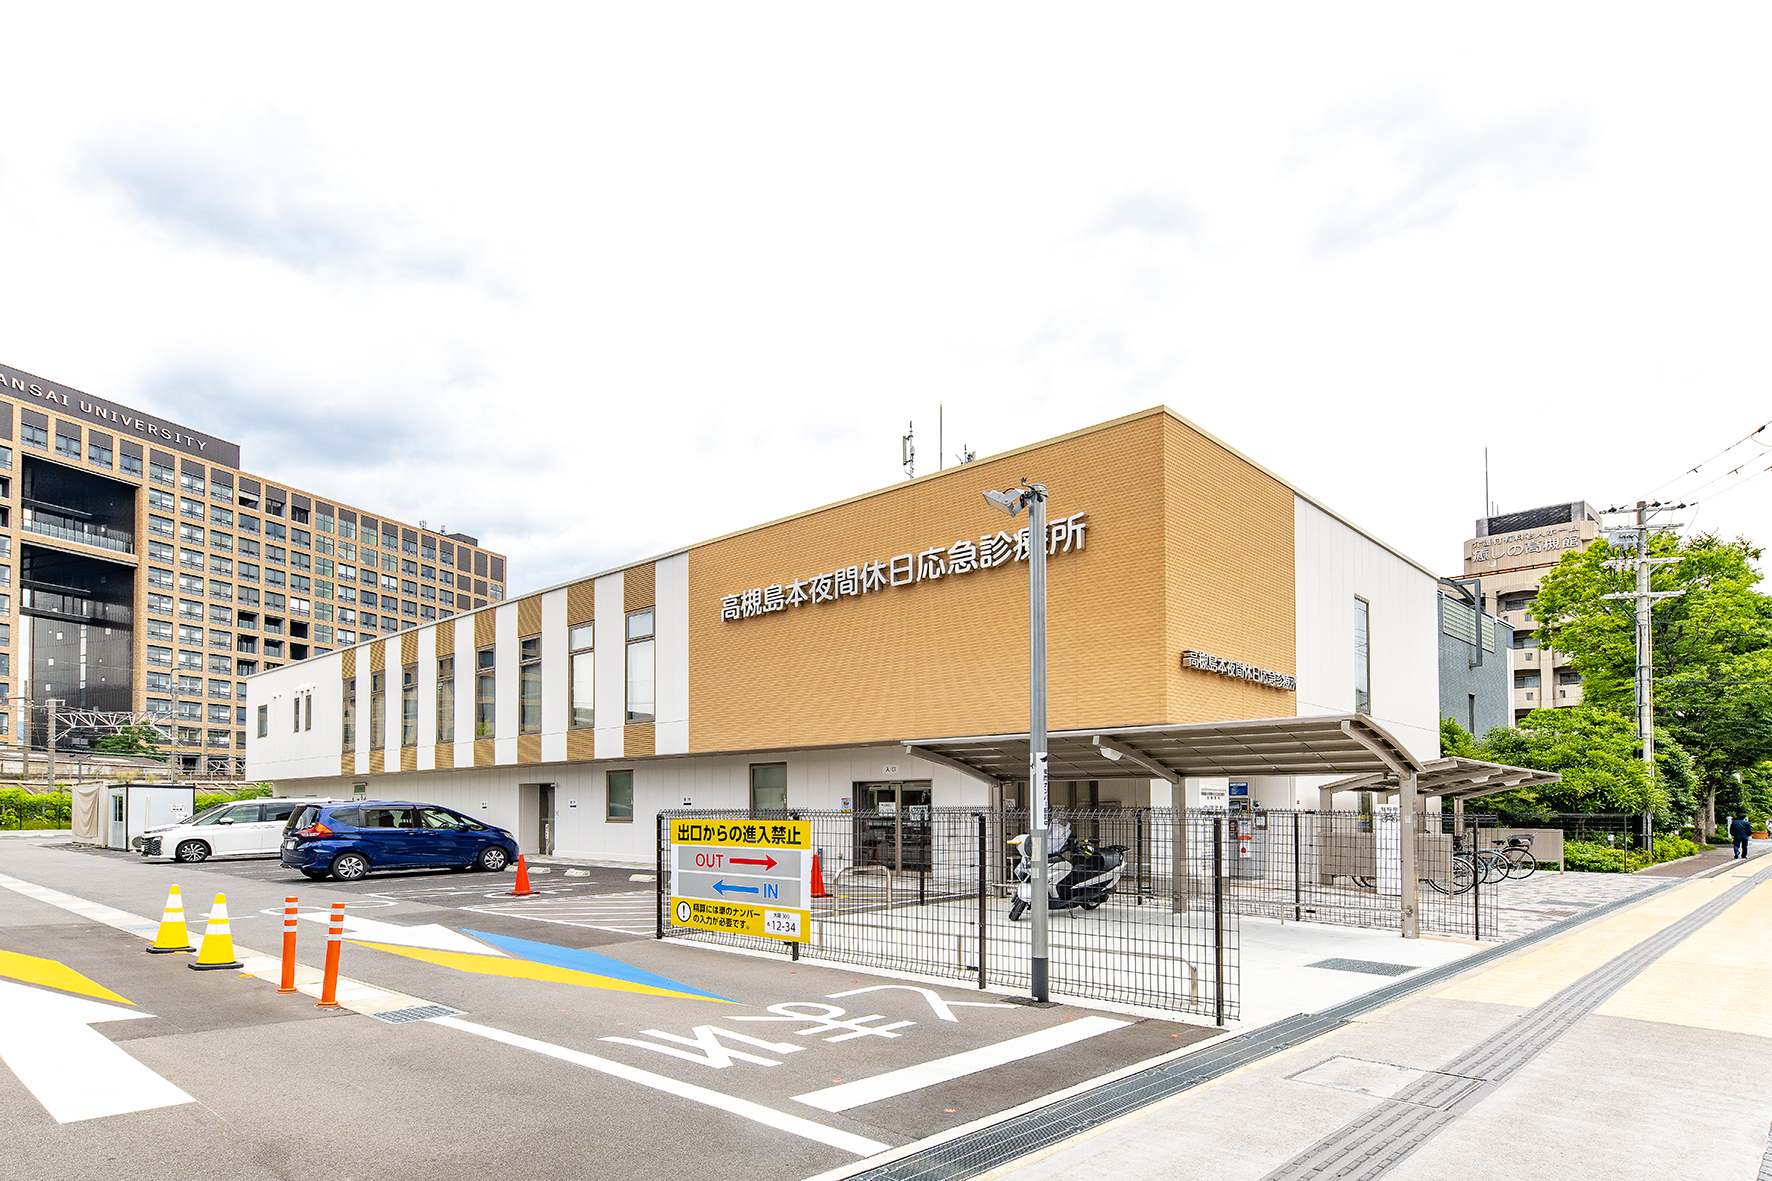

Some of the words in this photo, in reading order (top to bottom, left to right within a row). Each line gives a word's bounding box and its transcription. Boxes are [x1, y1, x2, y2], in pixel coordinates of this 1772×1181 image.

[80, 400, 208, 452] UNIVERSITY
[1472, 533, 1579, 563] 癒しの高槻館
[677, 823, 802, 845] 出口からの進入禁止
[695, 853, 724, 868] OUT
[763, 883, 779, 899] IN
[693, 914, 750, 930] の入力が必要です。
[771, 920, 797, 933] 12-34
[597, 985, 1022, 1069] とまれ
